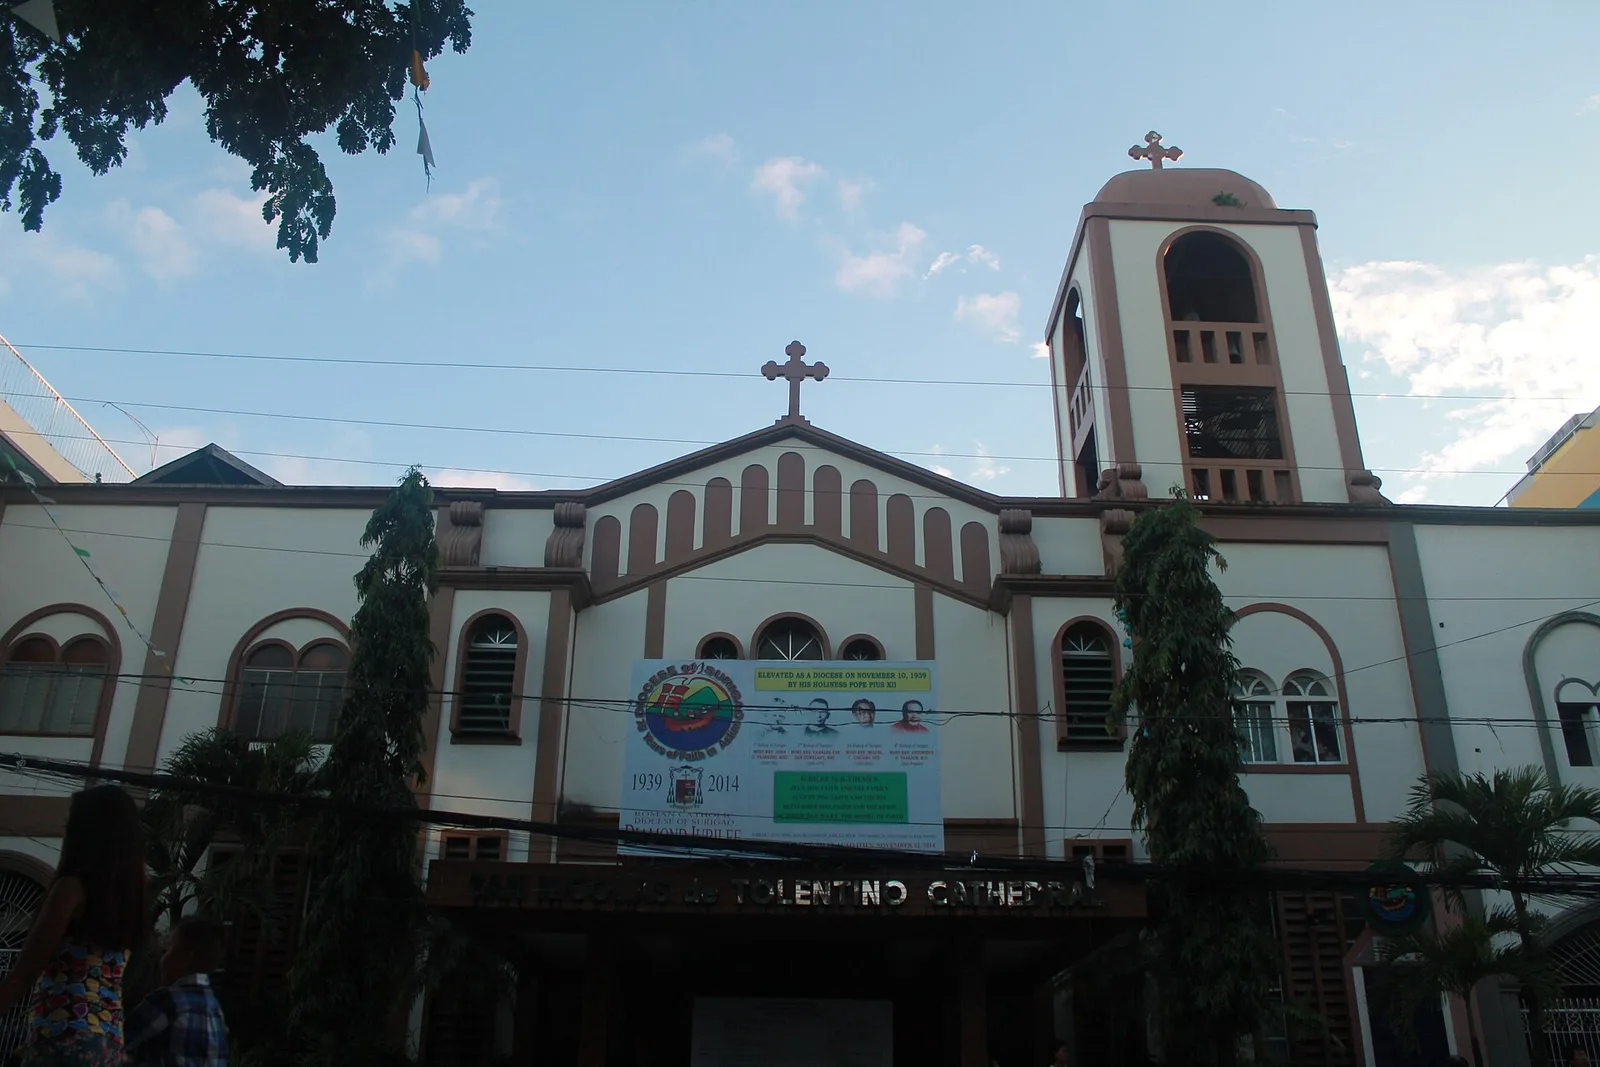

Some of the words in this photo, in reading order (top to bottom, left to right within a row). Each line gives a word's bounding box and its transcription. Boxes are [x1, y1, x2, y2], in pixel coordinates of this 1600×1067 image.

[897, 672, 908, 680] 10,
[632, 773, 662, 791] 1939
[708, 774, 740, 792] 2014
[691, 818, 735, 826] SURIGAO
[683, 877, 719, 905] de
[730, 878, 909, 907] TOLENTINO
[926, 880, 1108, 908] CATHEDRAL
